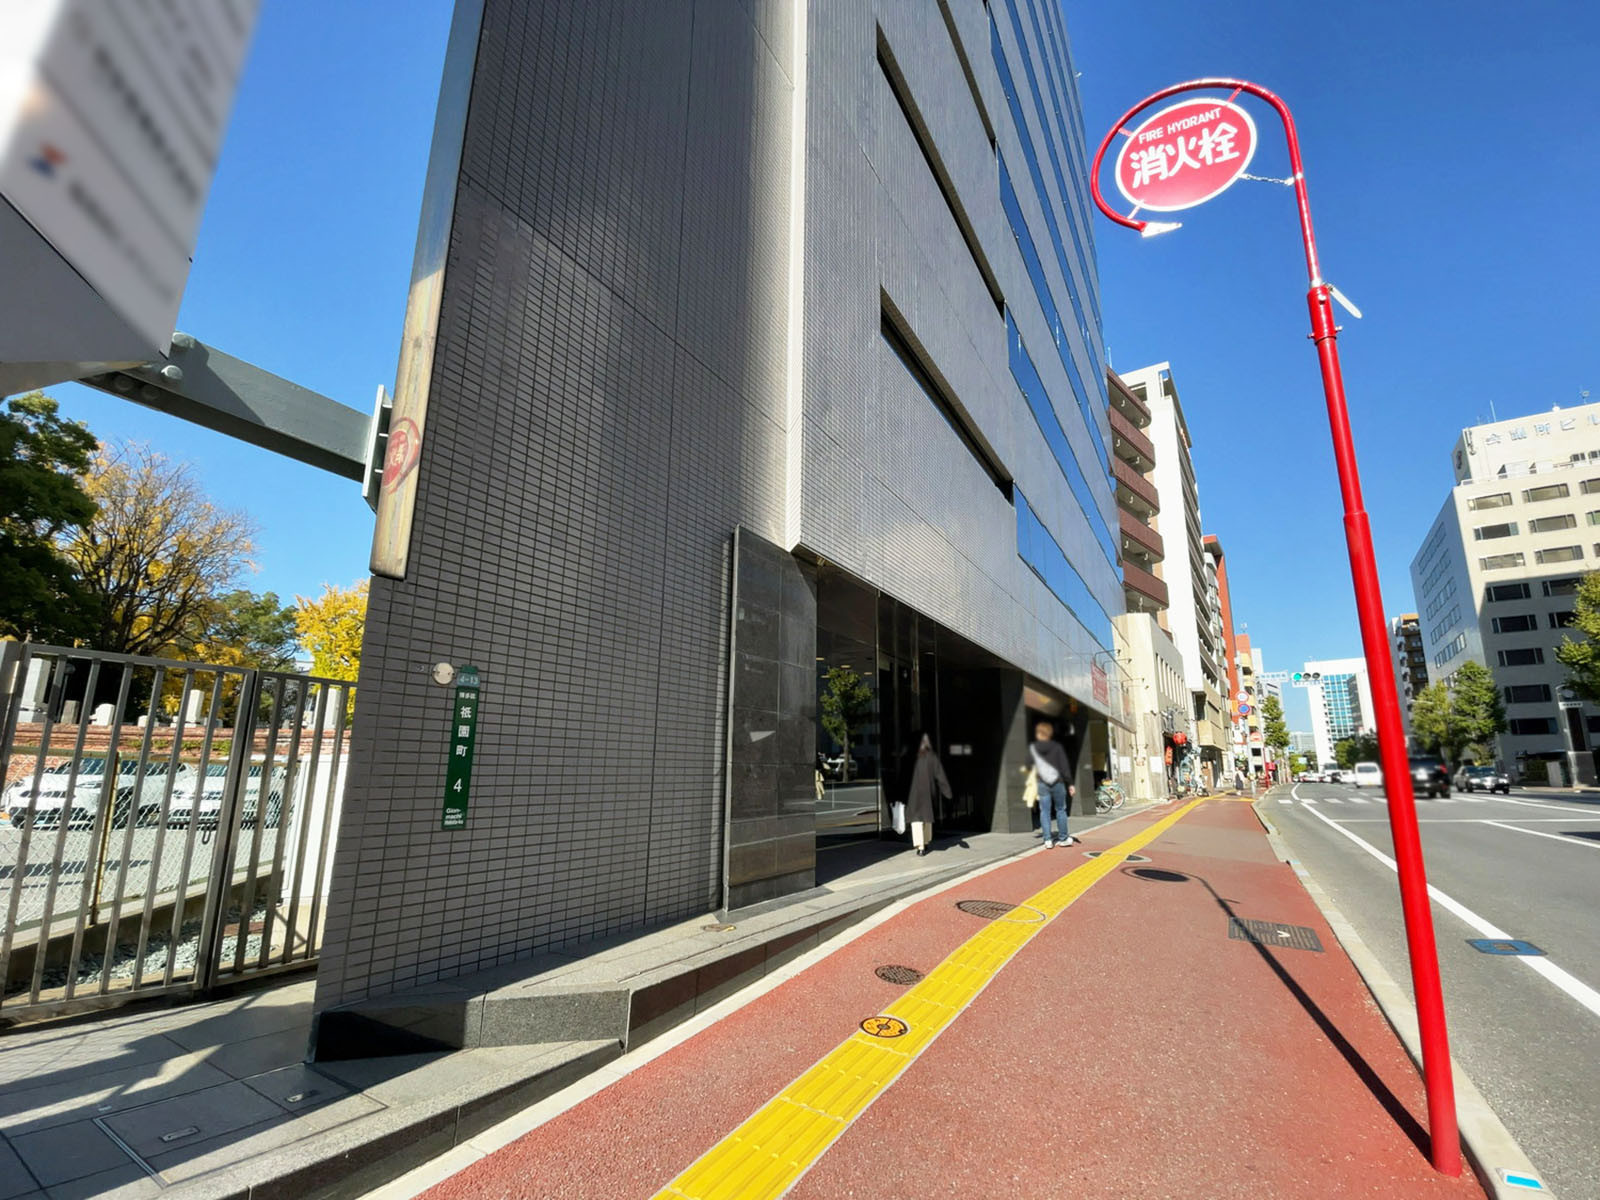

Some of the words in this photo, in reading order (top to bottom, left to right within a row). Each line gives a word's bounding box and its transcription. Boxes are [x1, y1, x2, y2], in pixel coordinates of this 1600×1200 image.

[1138, 127, 1164, 145] FIRE
[1167, 107, 1222, 135] HYDRANT
[1128, 122, 1240, 189] 消火栓
[453, 778, 463, 793] 4
